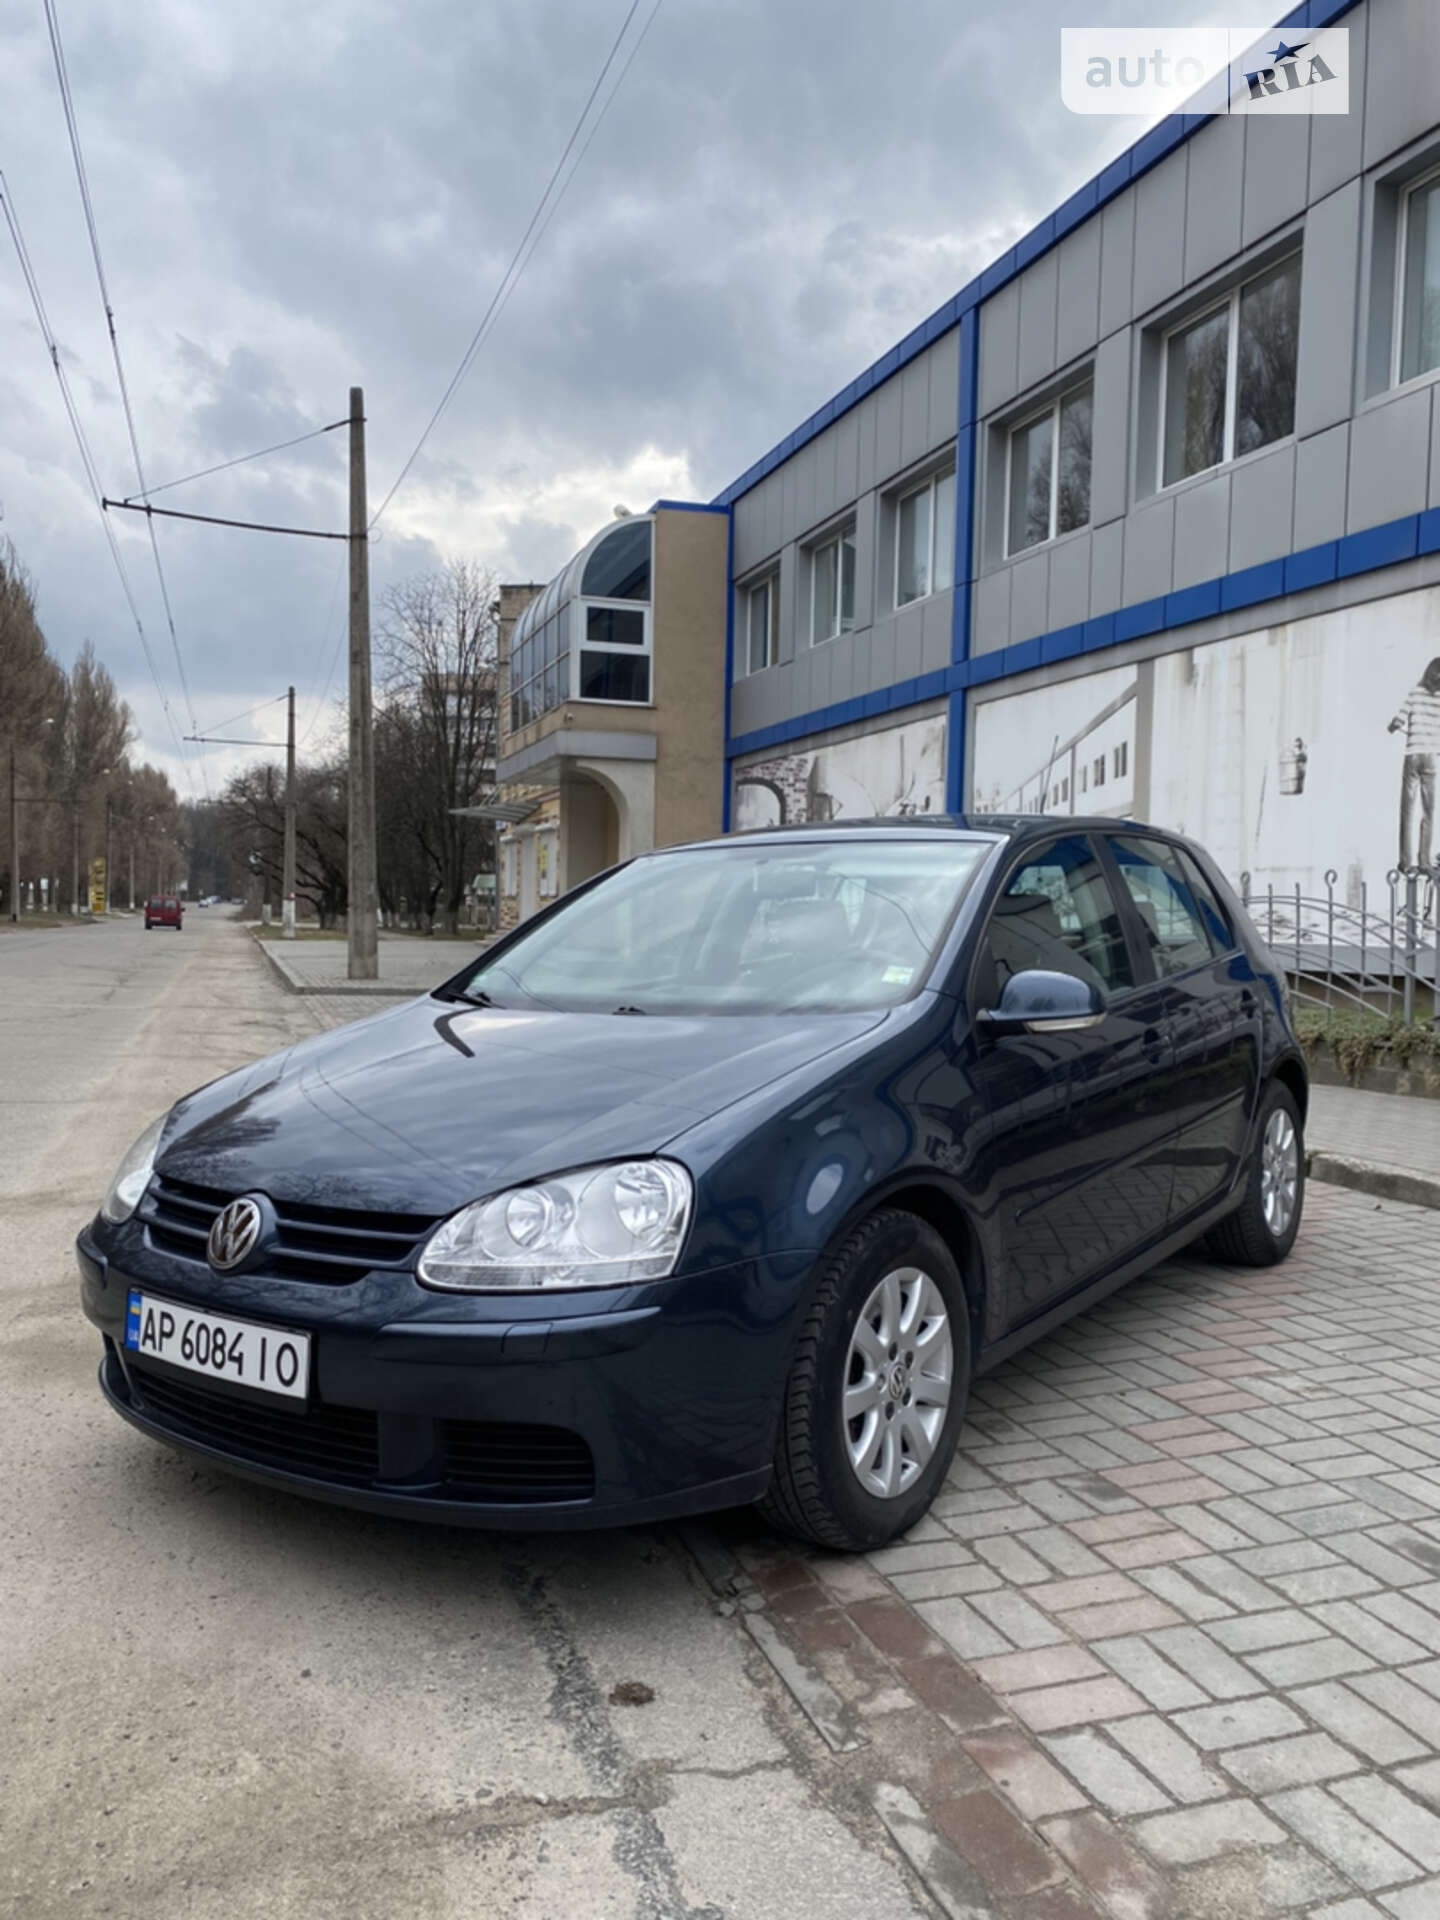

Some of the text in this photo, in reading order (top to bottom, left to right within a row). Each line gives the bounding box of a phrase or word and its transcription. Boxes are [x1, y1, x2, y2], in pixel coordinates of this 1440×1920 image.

[142, 1308, 299, 1388] AP 6084 IO
